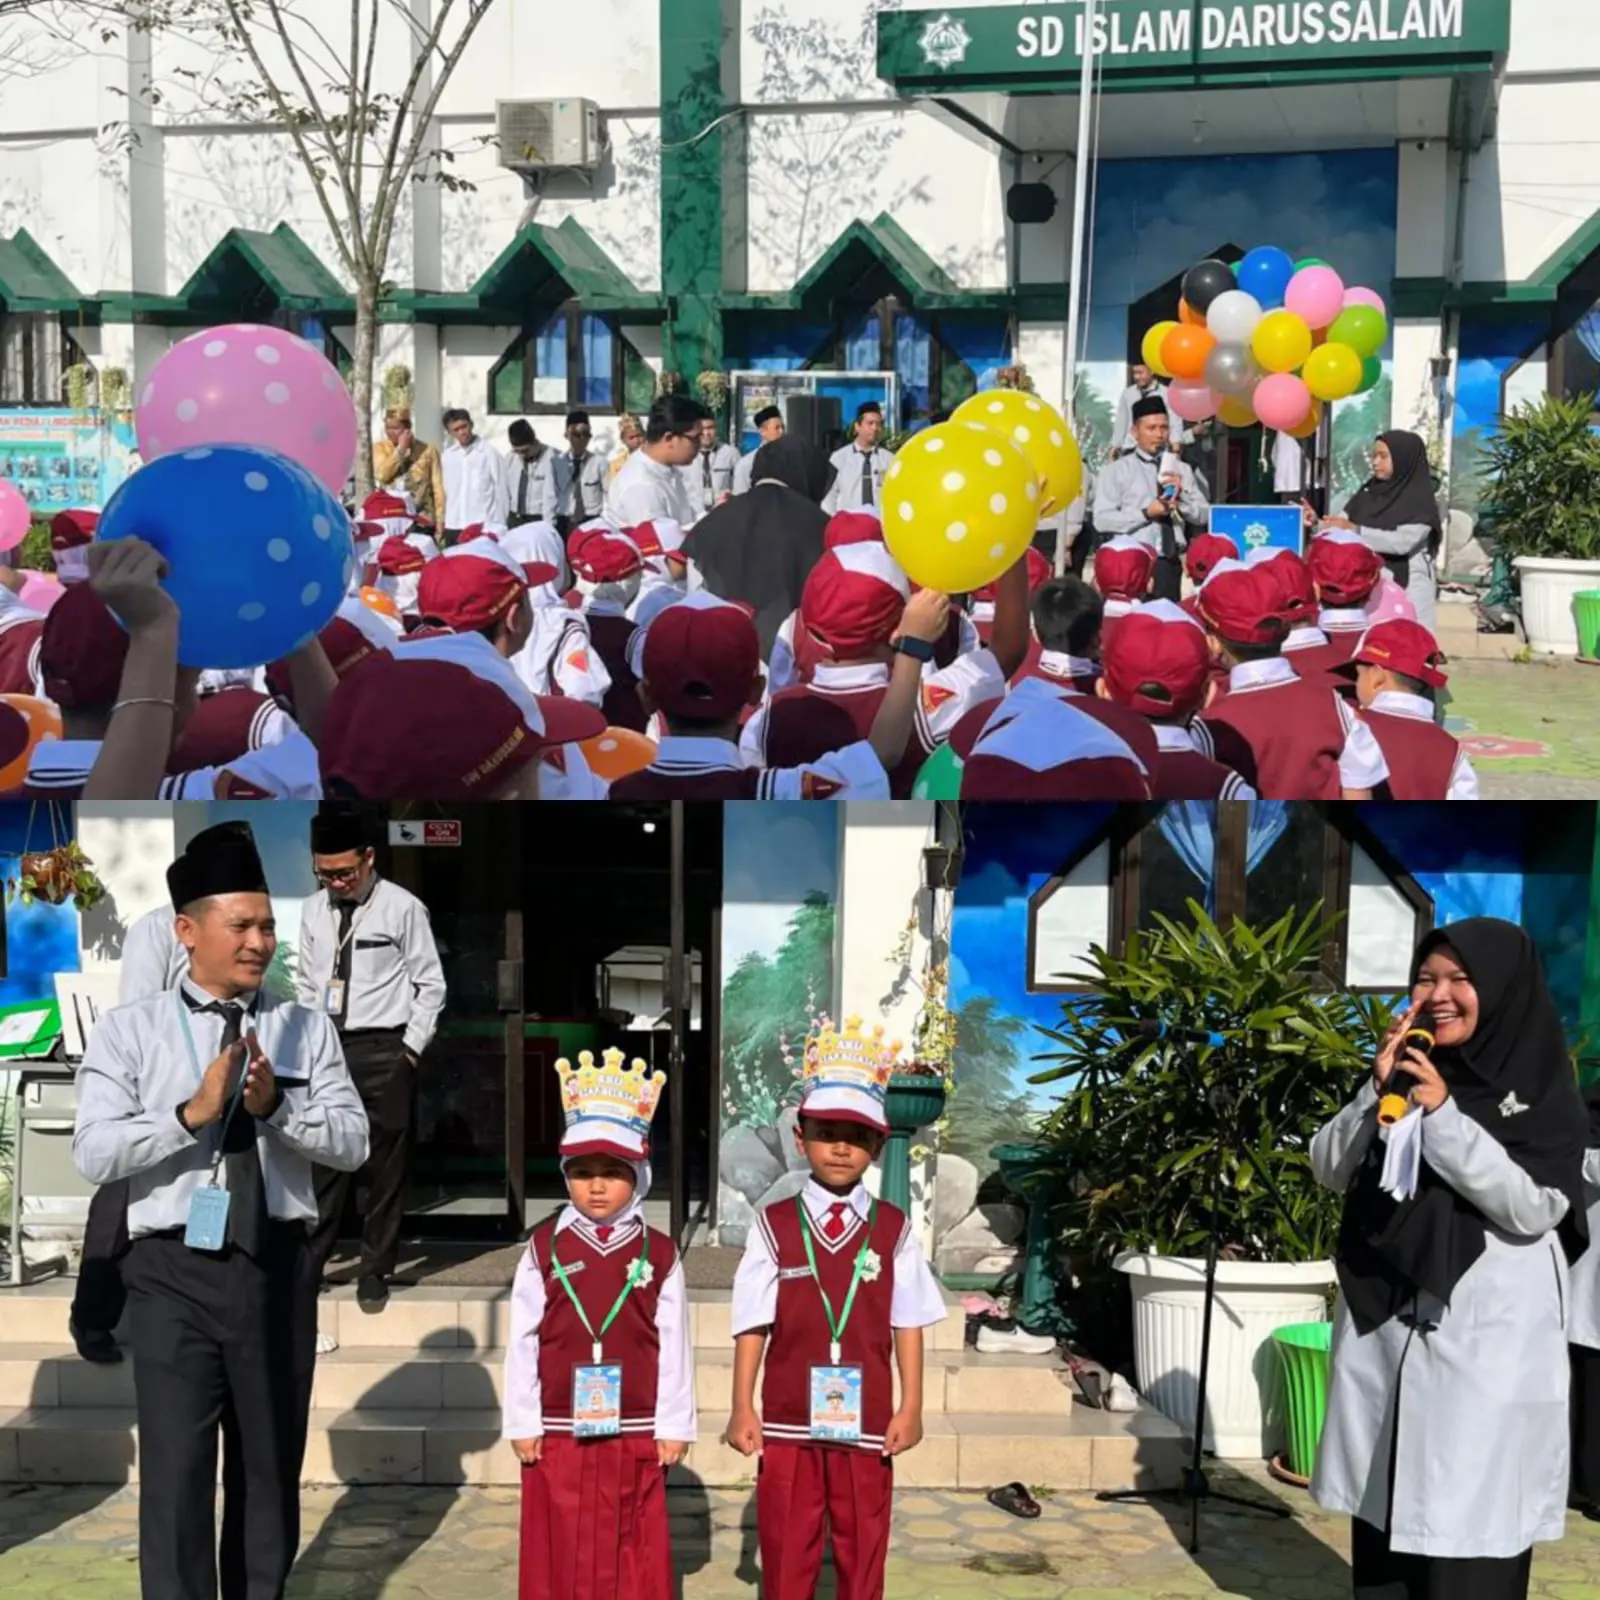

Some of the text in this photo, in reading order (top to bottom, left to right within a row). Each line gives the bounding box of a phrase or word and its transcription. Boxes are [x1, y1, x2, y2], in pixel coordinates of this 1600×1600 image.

[1016, 0, 1464, 57] SD ISLAM DARUSSALAM
